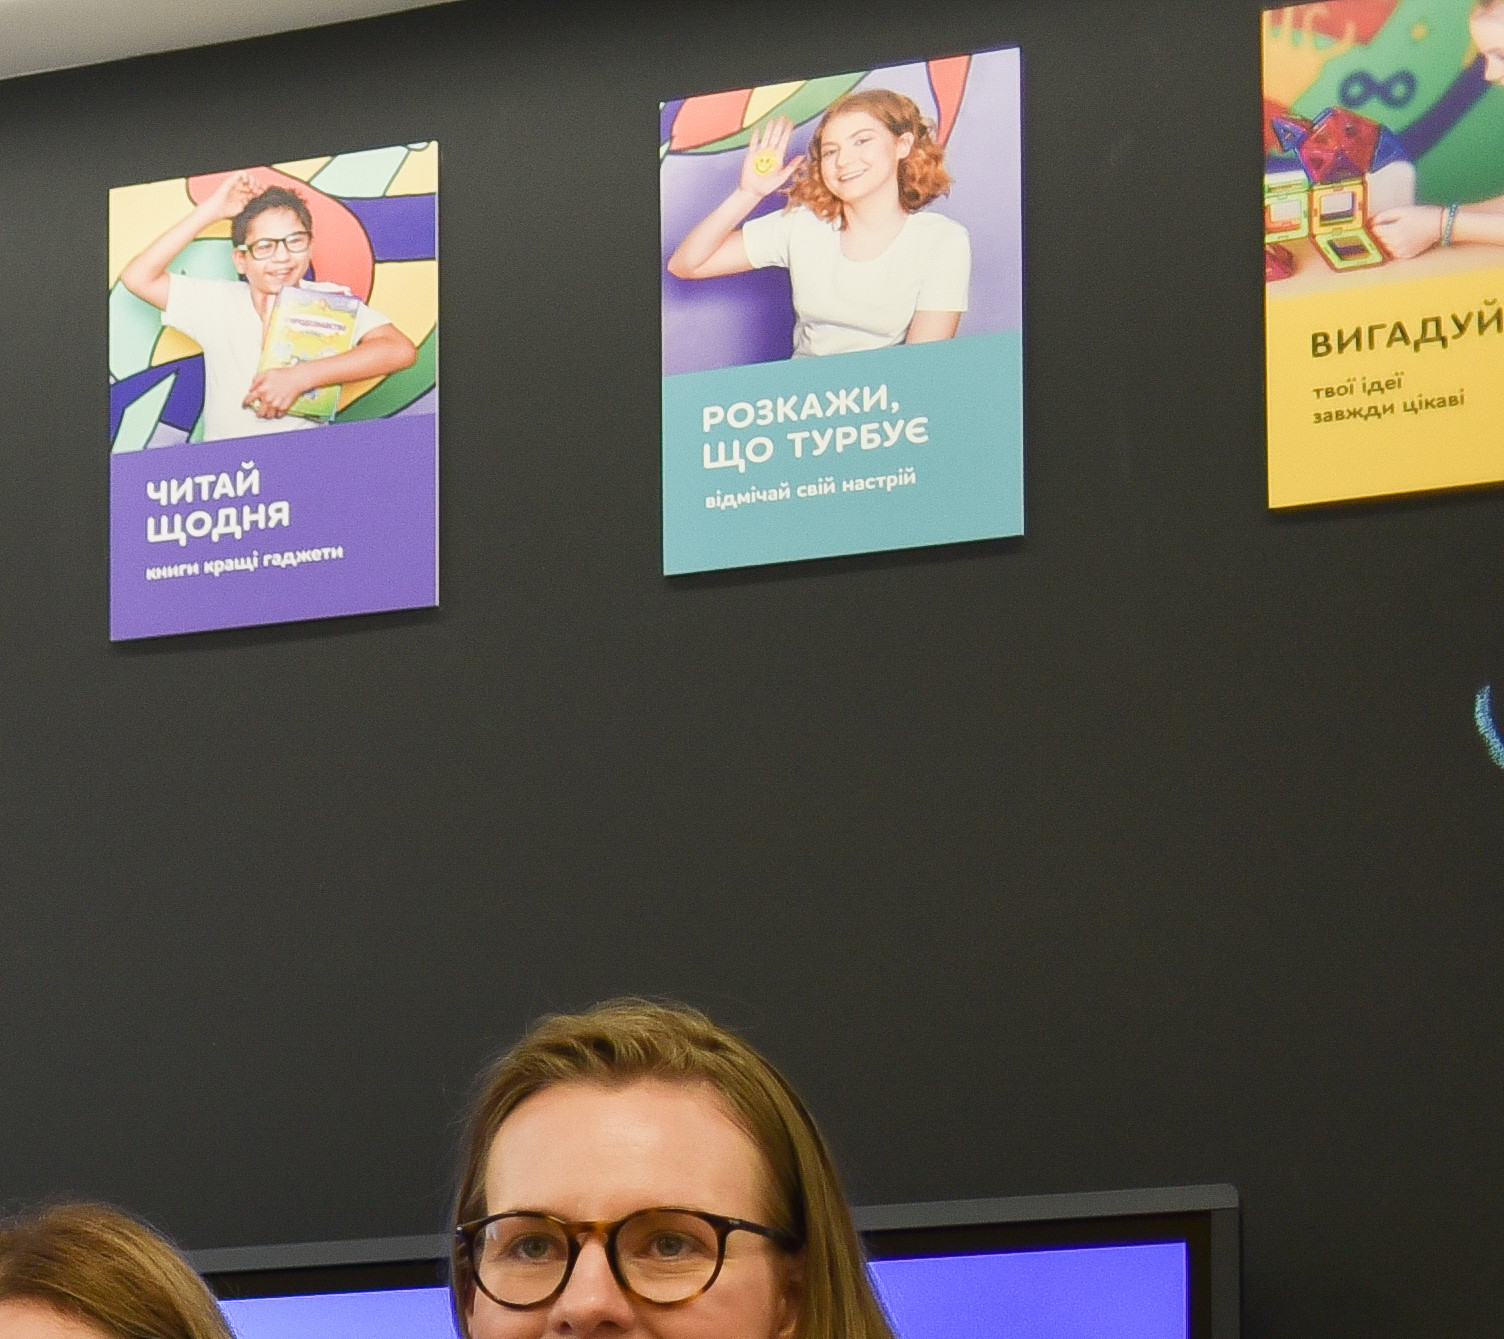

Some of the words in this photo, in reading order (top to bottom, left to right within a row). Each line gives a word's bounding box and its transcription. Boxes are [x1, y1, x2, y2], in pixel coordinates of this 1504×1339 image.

[1311, 298, 1504, 358] ВИГАДУЙ
[702, 384, 899, 432] РОЗКАЖИ,
[1312, 377, 1356, 400] твої
[1362, 371, 1404, 396] ідеї
[1313, 403, 1395, 424] завжди
[1403, 388, 1465, 415] цікаві
[702, 437, 774, 473] ЩО
[787, 416, 929, 458] ТУРБУЄ
[146, 460, 261, 506] ЧИТАЙ
[705, 483, 791, 511] відмічай
[796, 476, 837, 498] свій
[842, 467, 917, 492] настрій
[146, 501, 291, 547] ЩОДНЯ
[146, 561, 199, 580] книги
[204, 551, 259, 577] кращі
[263, 546, 344, 569] гаджети
